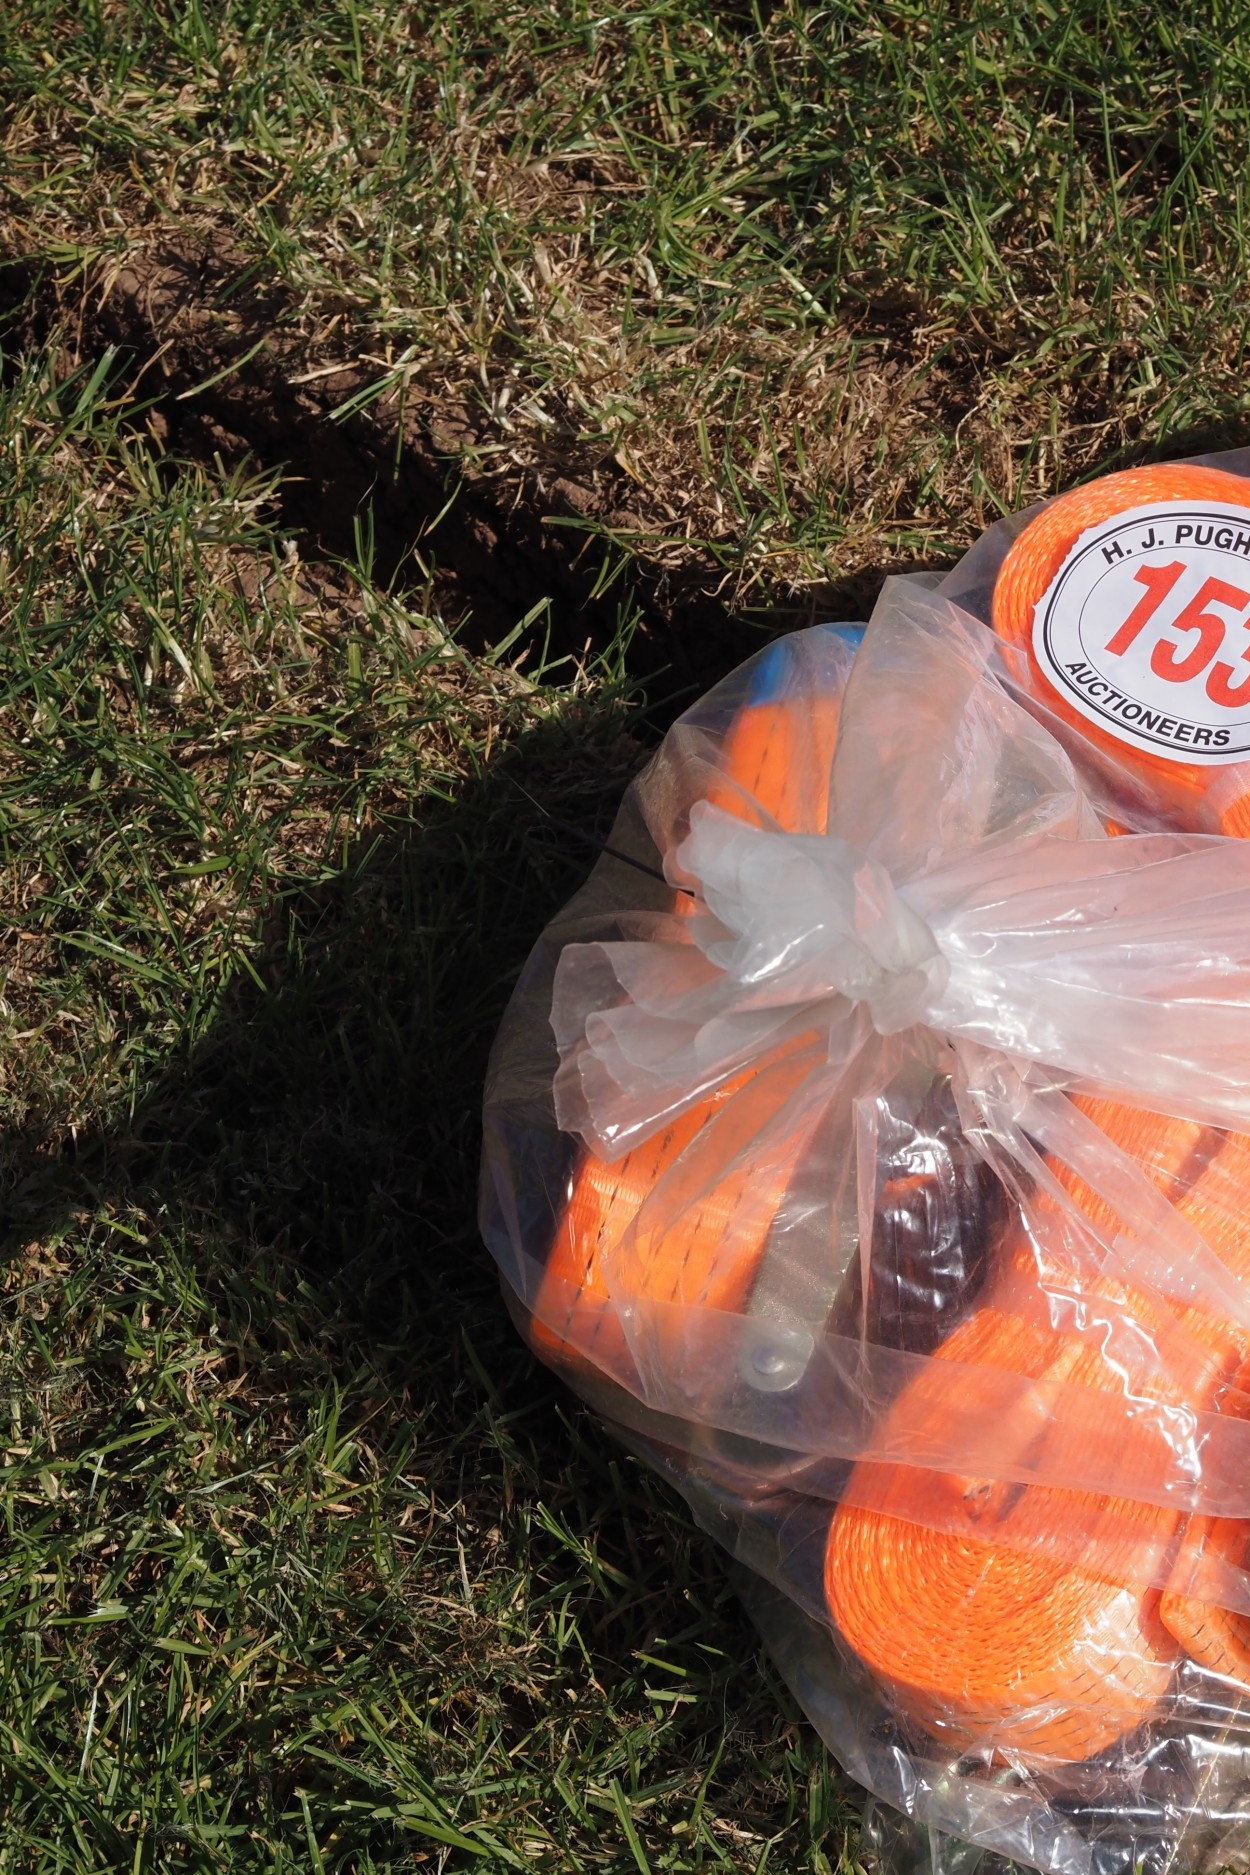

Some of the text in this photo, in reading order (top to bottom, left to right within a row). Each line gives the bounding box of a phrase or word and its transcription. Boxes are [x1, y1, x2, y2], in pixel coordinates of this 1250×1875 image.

[1101, 541, 1132, 565] H.
[1141, 528, 1164, 548] J.
[1064, 661, 1231, 746] AUCTIONEERS
